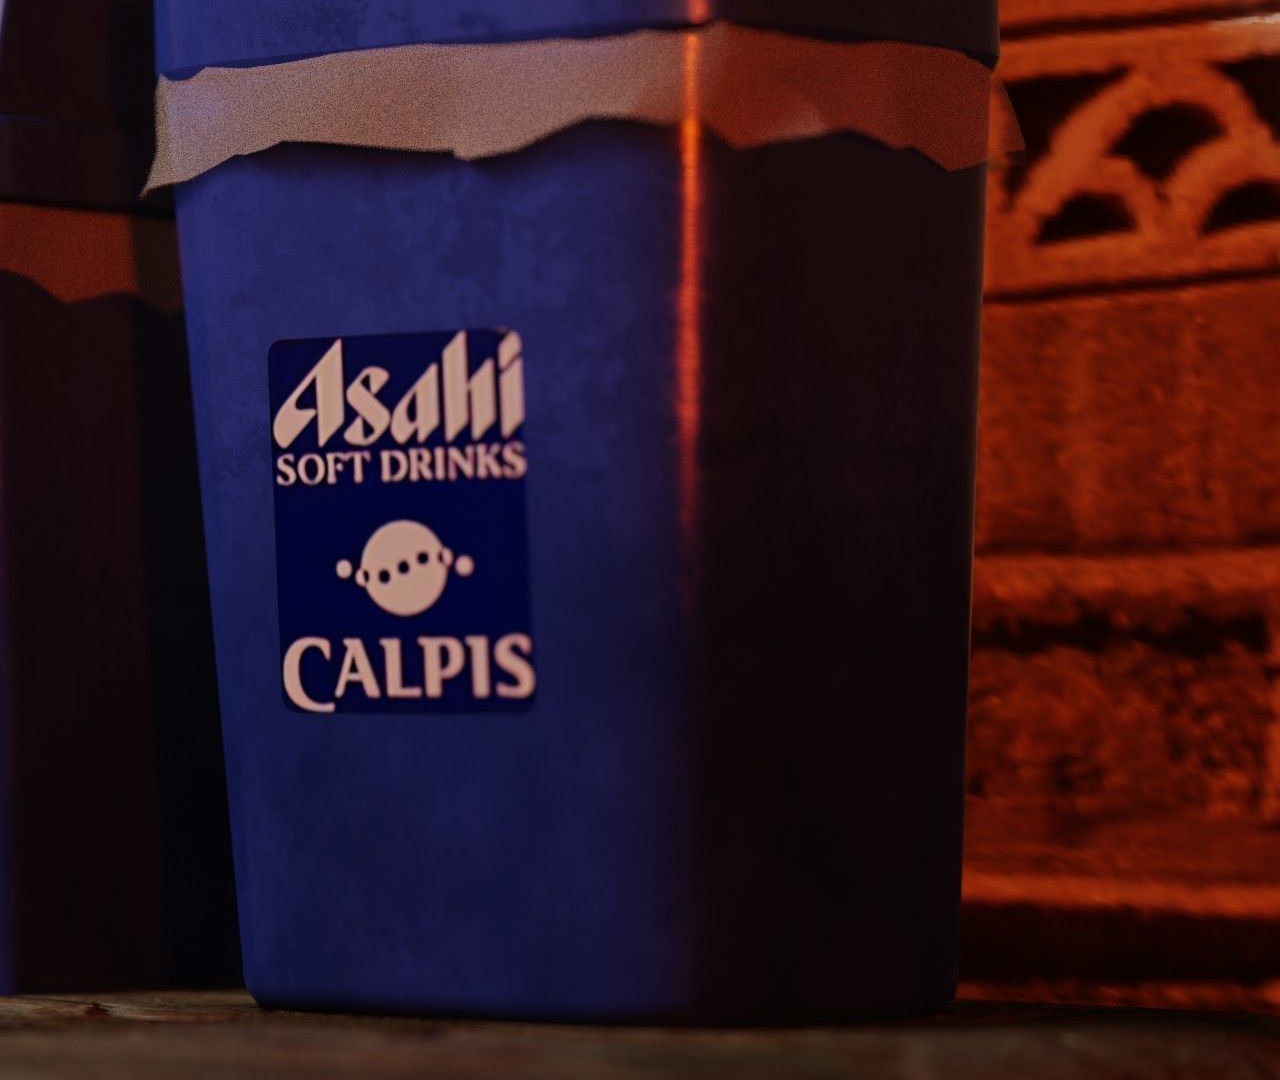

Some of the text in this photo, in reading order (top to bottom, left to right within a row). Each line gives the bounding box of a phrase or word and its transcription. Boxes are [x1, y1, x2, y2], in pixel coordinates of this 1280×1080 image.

[272, 329, 526, 450] Asahi
[276, 440, 528, 487] SOFT DRINKS
[283, 633, 537, 713] CALPIS
